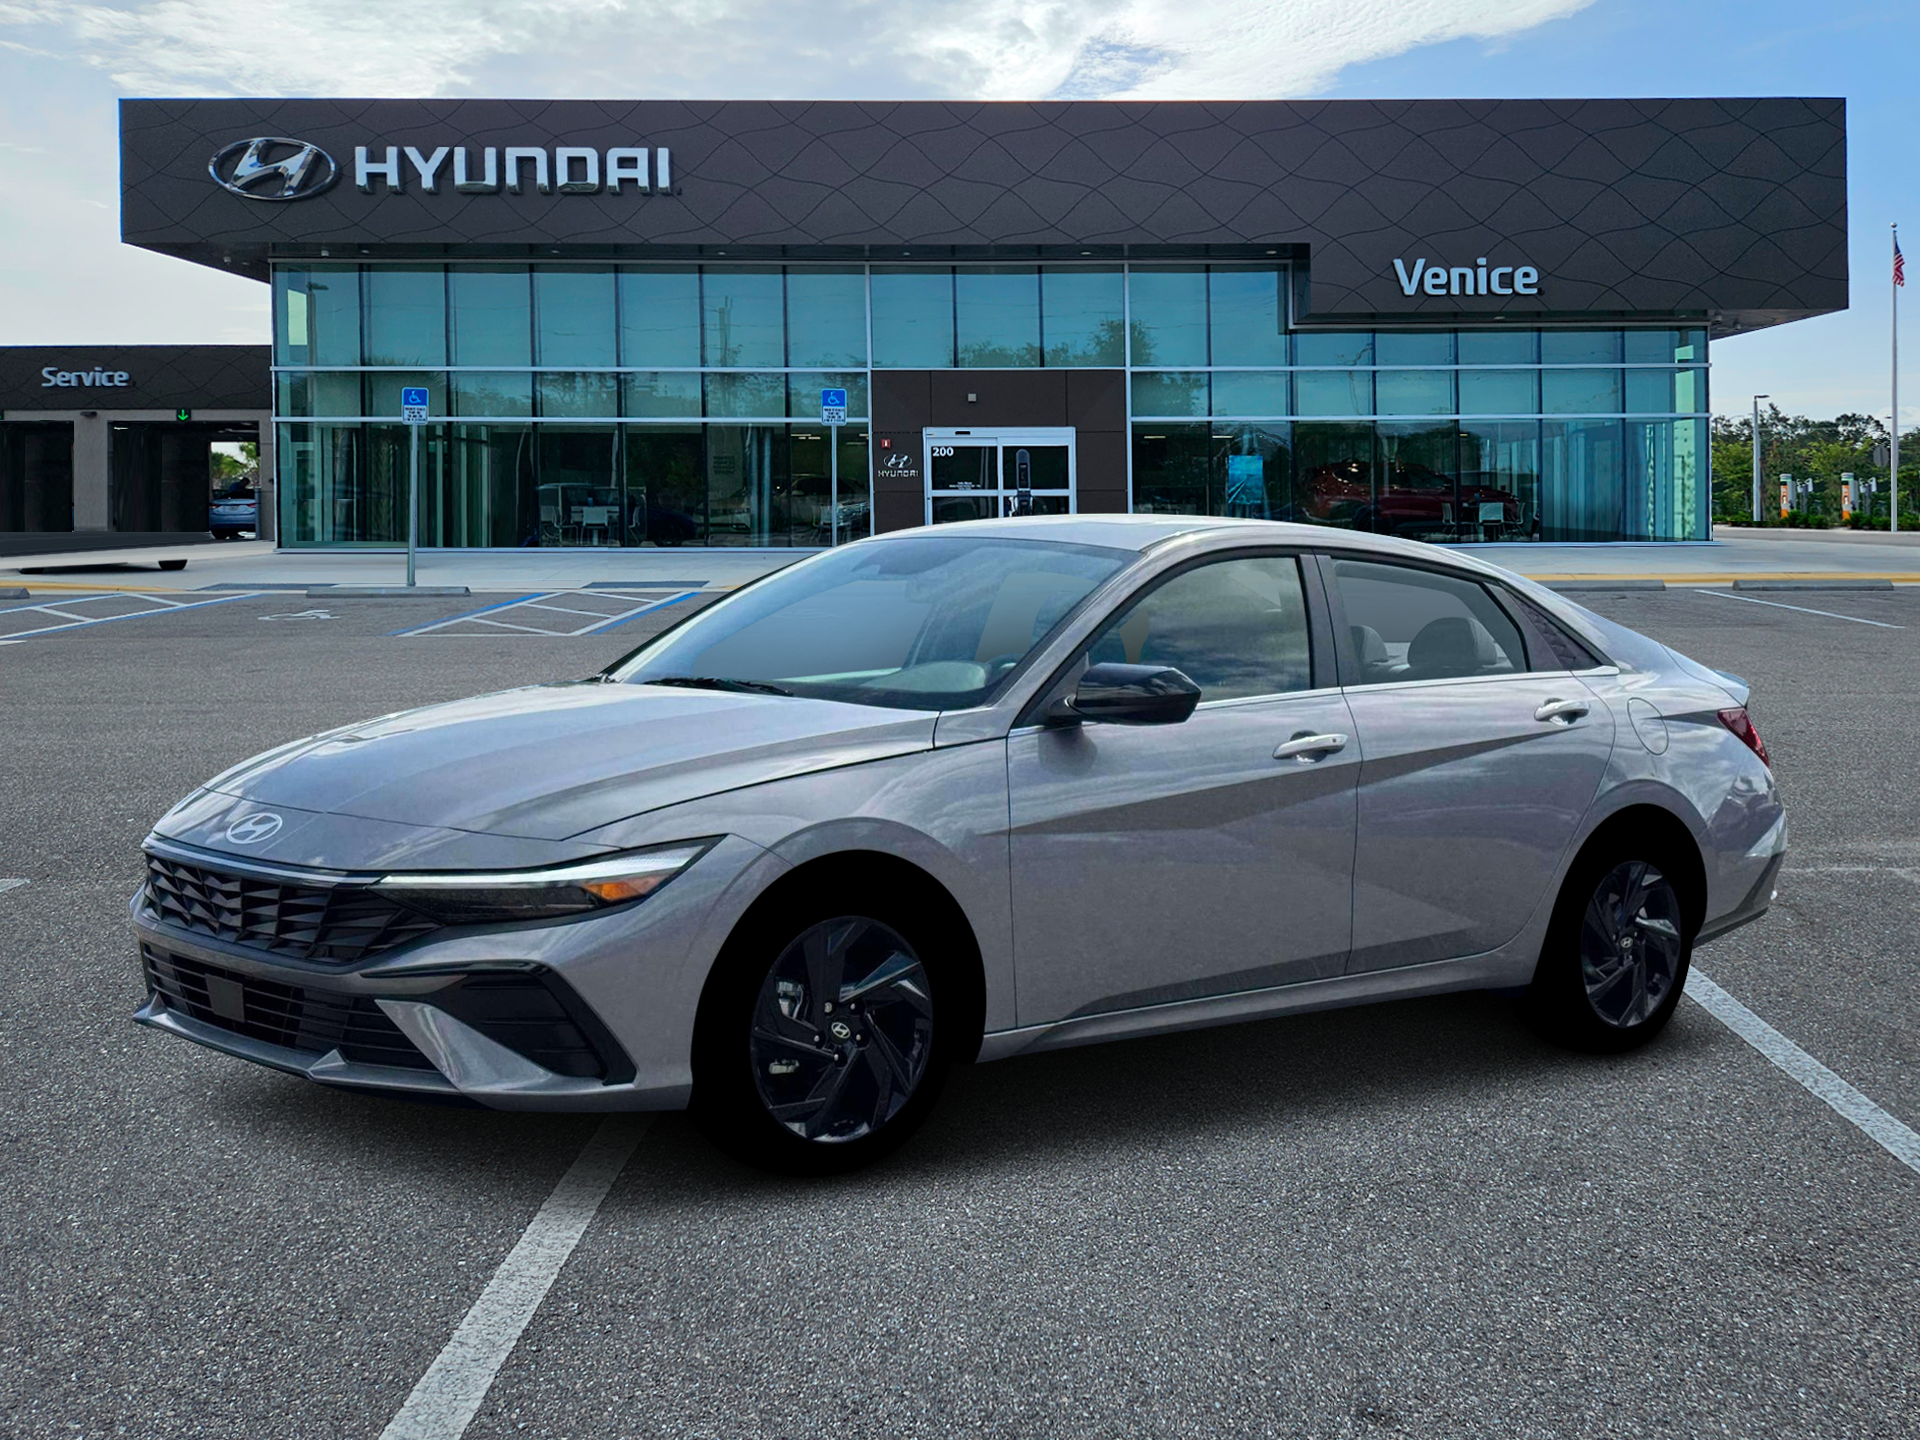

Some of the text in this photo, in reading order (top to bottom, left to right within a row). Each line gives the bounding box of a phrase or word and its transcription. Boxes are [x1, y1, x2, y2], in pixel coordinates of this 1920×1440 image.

[354, 145, 672, 193] HYUNDAI
[1393, 257, 1539, 297] Venice
[41, 366, 130, 387] Service
[932, 446, 954, 457] 200
